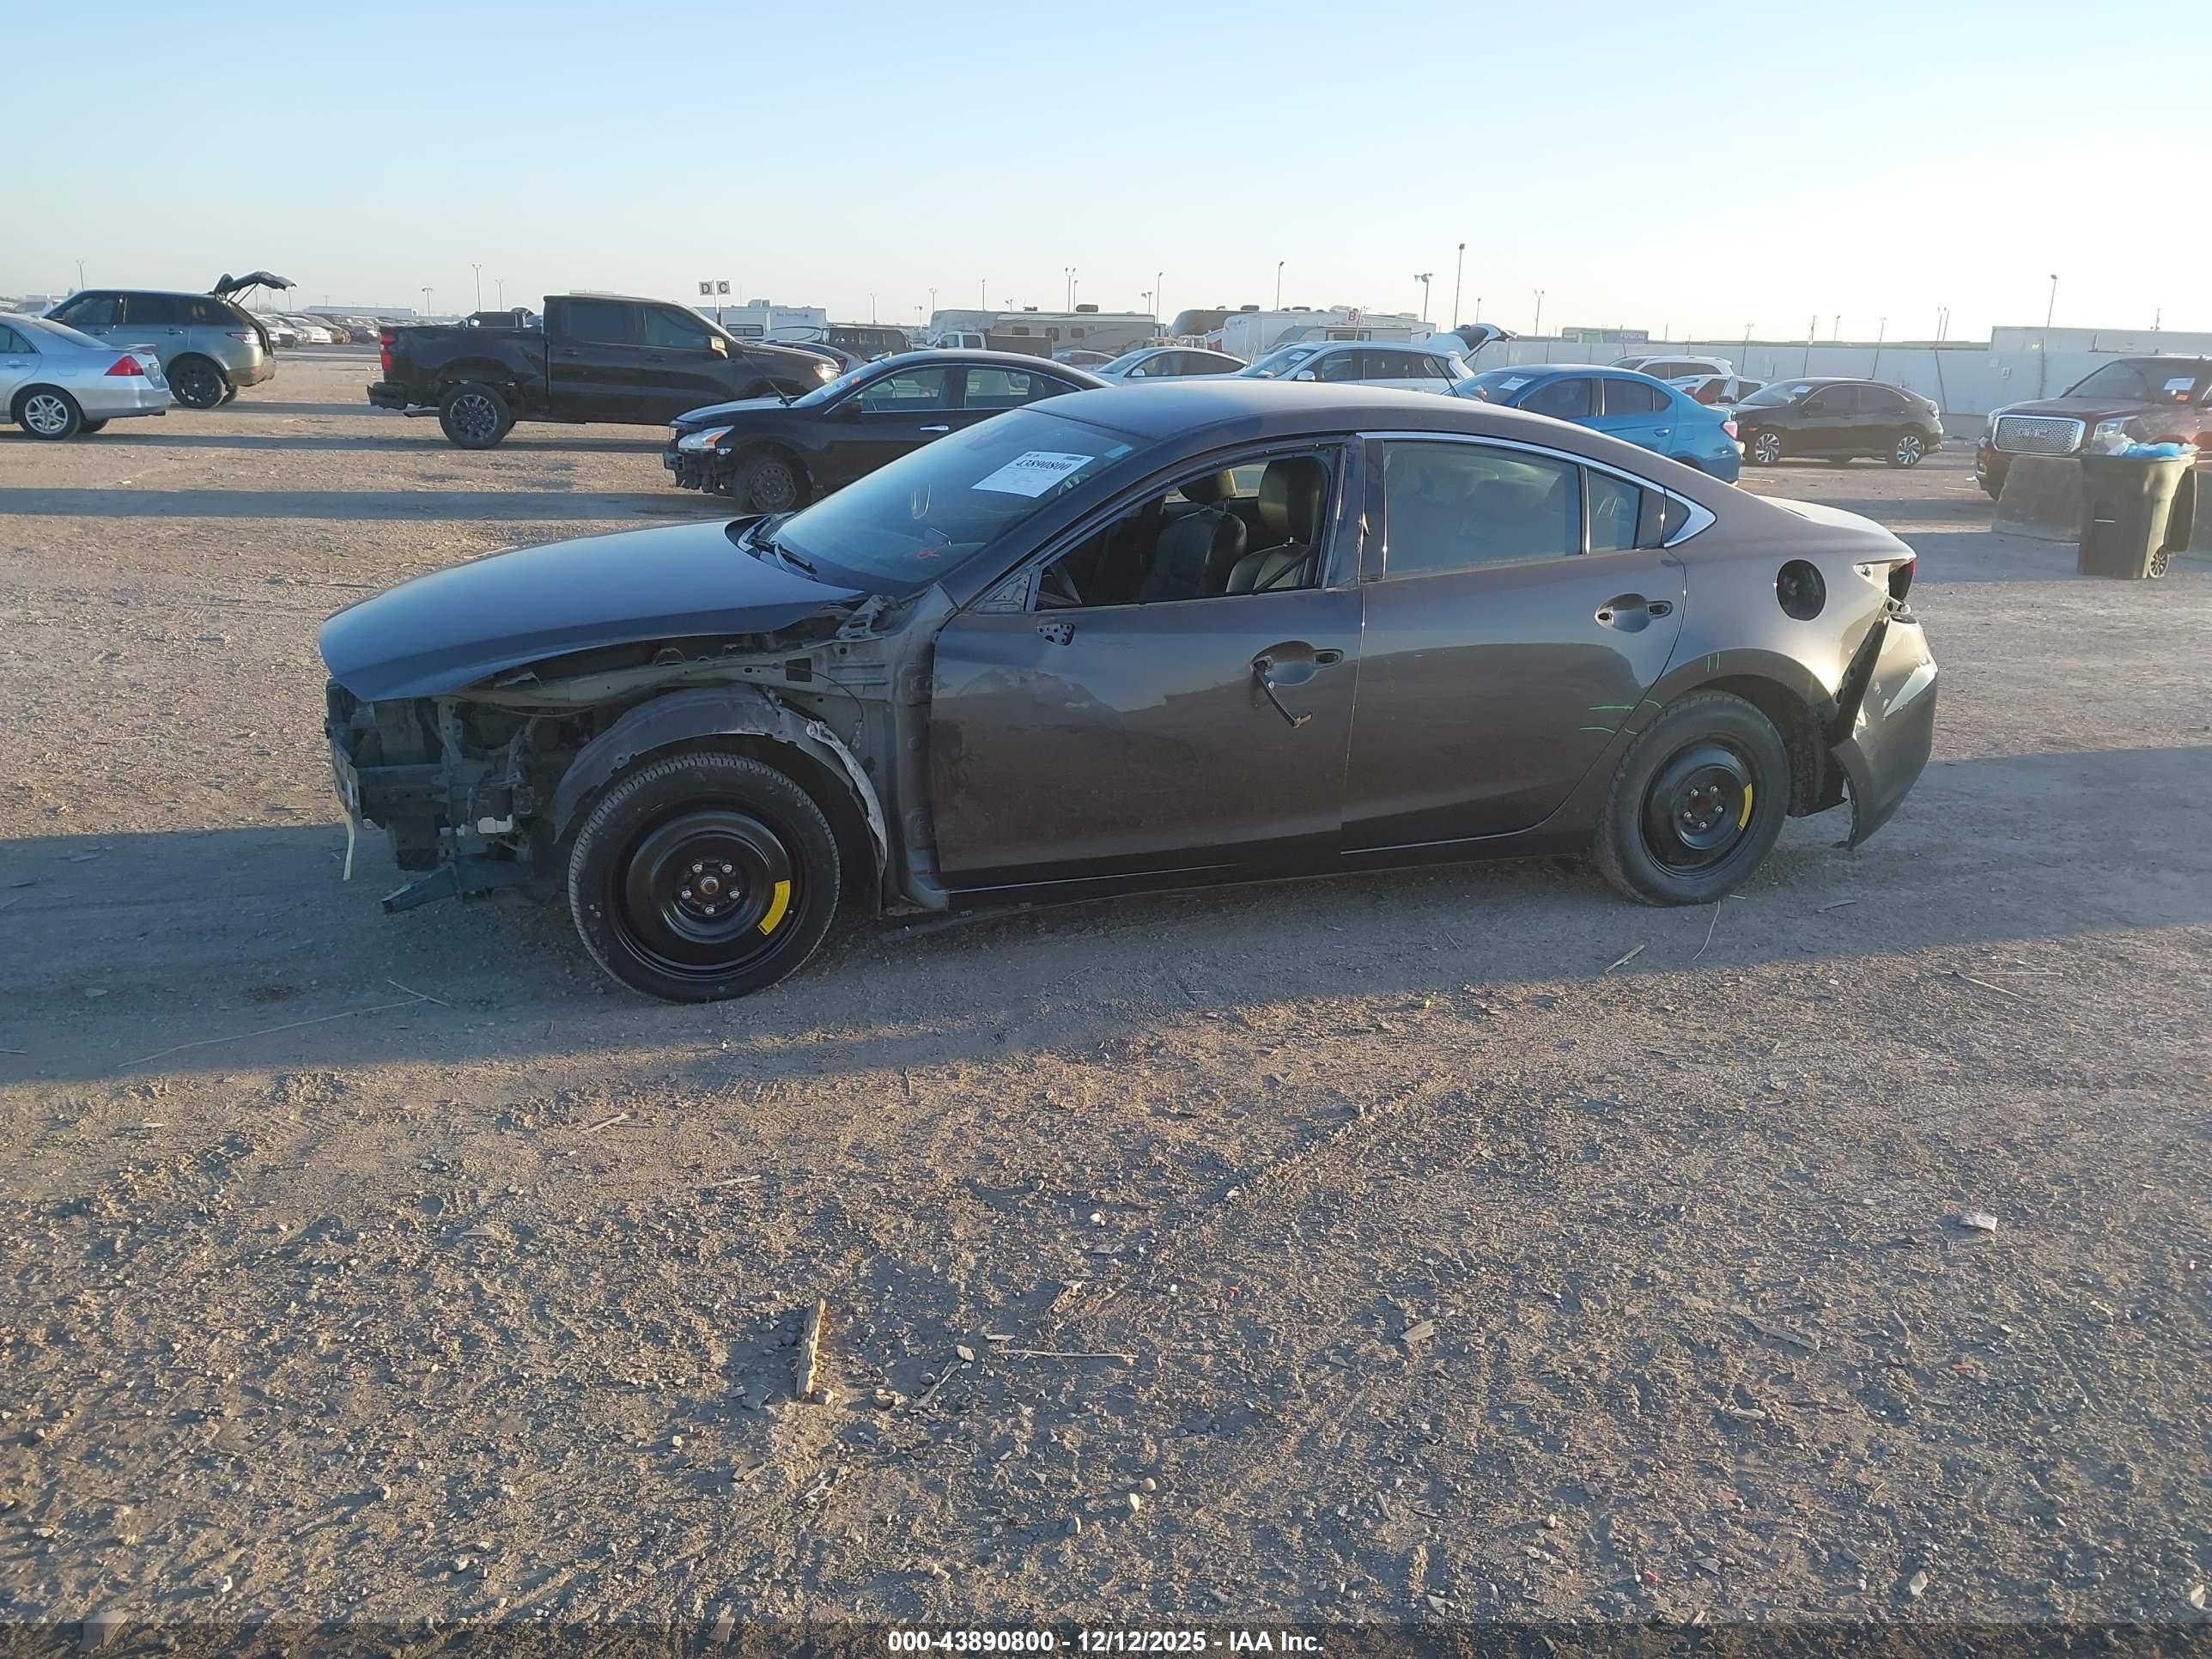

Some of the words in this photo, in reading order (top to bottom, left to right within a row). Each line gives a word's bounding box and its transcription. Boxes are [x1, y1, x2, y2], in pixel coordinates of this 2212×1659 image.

[702, 283, 711, 295] D
[718, 282, 728, 294] C
[1348, 311, 1356, 321] B
